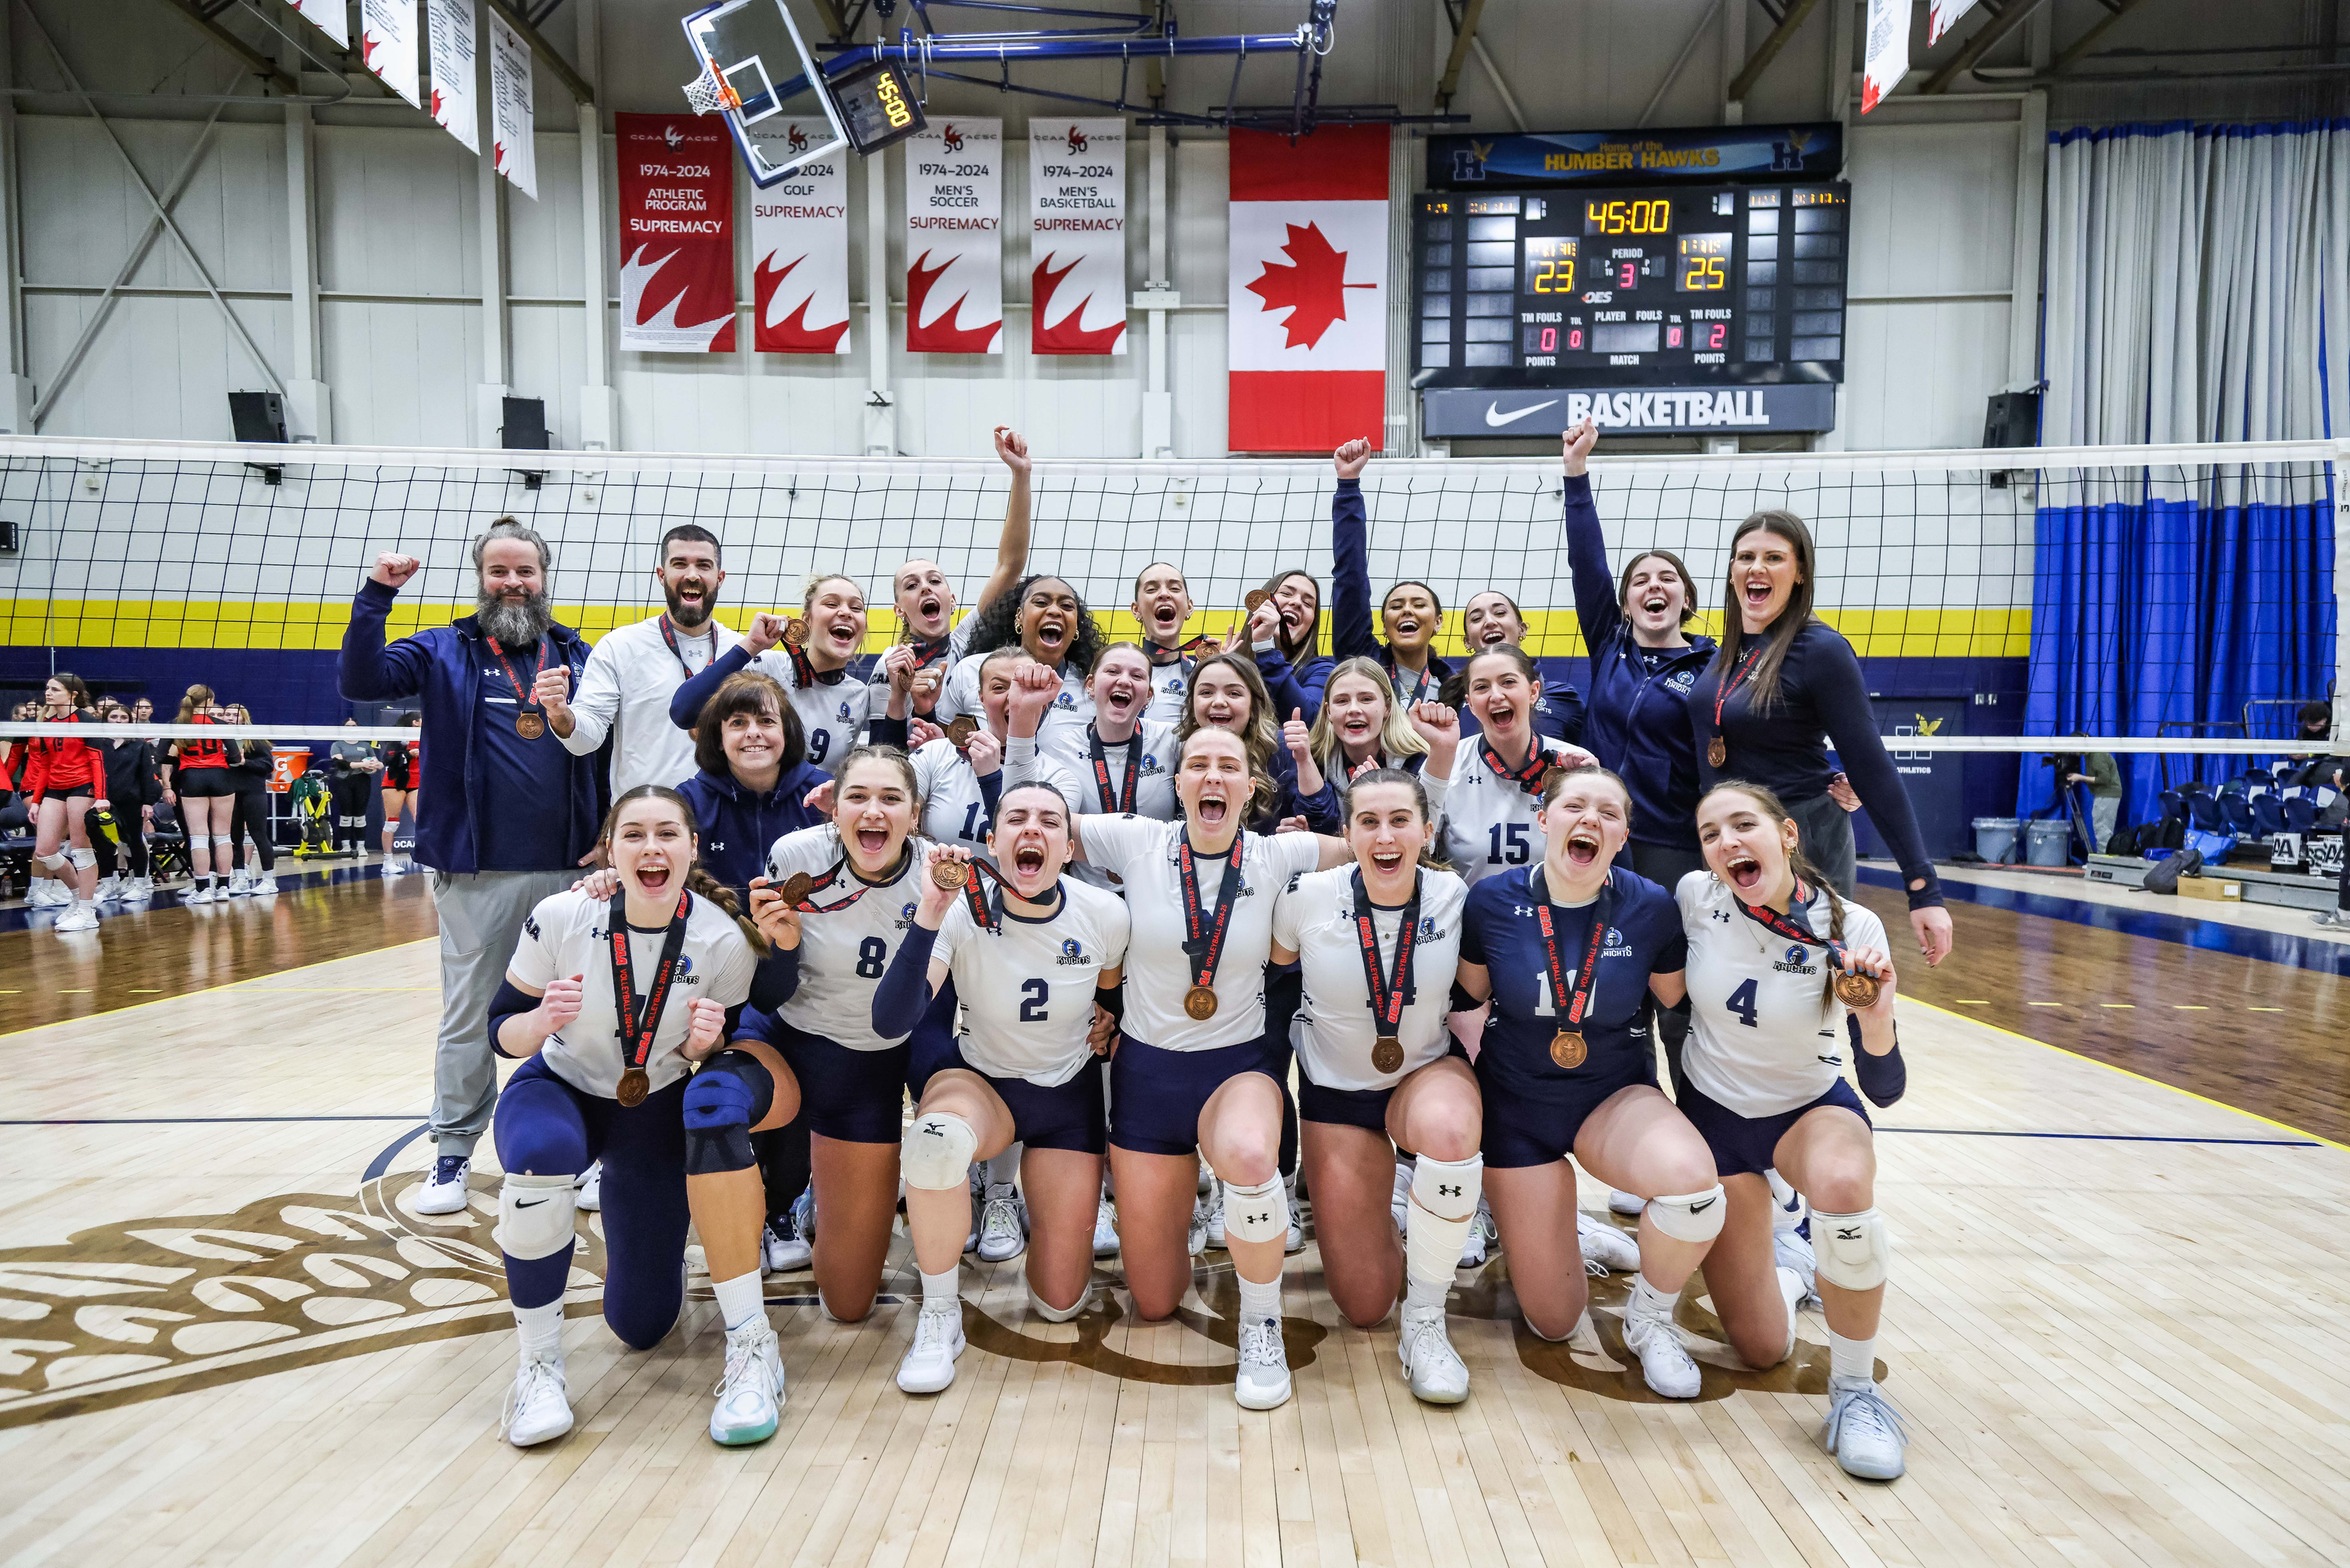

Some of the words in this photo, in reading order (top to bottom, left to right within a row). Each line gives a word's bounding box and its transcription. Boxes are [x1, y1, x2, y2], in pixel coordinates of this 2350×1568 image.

[877, 72, 911, 128] 45:00
[944, 139, 963, 154] 50
[1068, 141, 1087, 155] 50
[1545, 152, 1633, 170] HUMBER
[1641, 148, 1720, 168] HAWKS
[647, 189, 704, 200] ATHLETIC
[784, 186, 815, 196] GOLF
[935, 185, 973, 195] MEN'S
[1059, 187, 1097, 197] MEN'S
[645, 200, 707, 211] PROGRAM
[755, 205, 845, 218] SUPREMACY
[930, 197, 978, 207] SOCCER
[1040, 198, 1116, 208] BASKETBALL
[630, 218, 722, 233] SUPREMACY
[910, 217, 998, 230] SUPREMACY
[1034, 218, 1123, 231] SUPREMACY
[1588, 200, 1670, 234] 45:00
[1612, 248, 1643, 259] PERIOD
[1534, 259, 1575, 293] 23
[1620, 263, 1635, 288] 3
[1685, 257, 1725, 290] 25
[1522, 313, 1534, 323] TM
[1536, 312, 1562, 323] FOULS
[1595, 311, 1626, 322] PLAYER
[1636, 310, 1663, 321] FOULS
[1690, 310, 1703, 320] TM
[1705, 309, 1732, 319] FOULS
[1540, 328, 1557, 352] 0
[1709, 324, 1726, 348] 2
[1526, 356, 1556, 367] POINTS
[1610, 355, 1640, 366] MATCH
[1694, 353, 1725, 364] POINTS
[1568, 391, 1769, 427] BASKETBALL
[807, 728, 830, 765] 9
[274, 757, 288, 771] G
[1095, 760, 1108, 784] OCAA
[1485, 751, 1507, 774] OCAA
[1231, 838, 1242, 868] OCAA
[1487, 823, 1530, 865] 15
[1180, 843, 1192, 874] OCAA
[1186, 875, 1197, 917] VOLLEYBALL
[1191, 916, 1200, 939] 2024-25
[1206, 928, 1222, 967] VOLLEYBALL
[1218, 904, 1228, 927] 2024-25
[613, 933, 627, 966] OCAA
[856, 936, 887, 979] 8
[1056, 955, 1091, 967] KNIGHTS
[1359, 917, 1374, 948] OCAA
[1368, 950, 1380, 994] VOLLEYBALL
[1538, 906, 1554, 937] OCAA
[1547, 940, 1561, 982] VOLLEYBALL
[1556, 983, 1567, 1007] 2024-25
[1388, 991, 1402, 1023] OCAA
[1396, 947, 1409, 988] VOLLEYBALL
[1404, 922, 1413, 946] 2024-25
[1569, 991, 1587, 1023] OCAA
[1580, 948, 1597, 988] VOLLEYBALL
[1592, 923, 1604, 946] 2024-25
[1773, 961, 1817, 975] KNIGHTS
[620, 968, 631, 1012] VOLLEYBALL
[1020, 978, 1049, 1022] 2
[635, 1031, 652, 1065] OCAA
[646, 985, 664, 1028] VOLLEYBALL
[661, 960, 671, 984] 2024-25
[1726, 978, 1758, 1028] 4
[624, 1013, 634, 1038] 2024-25
